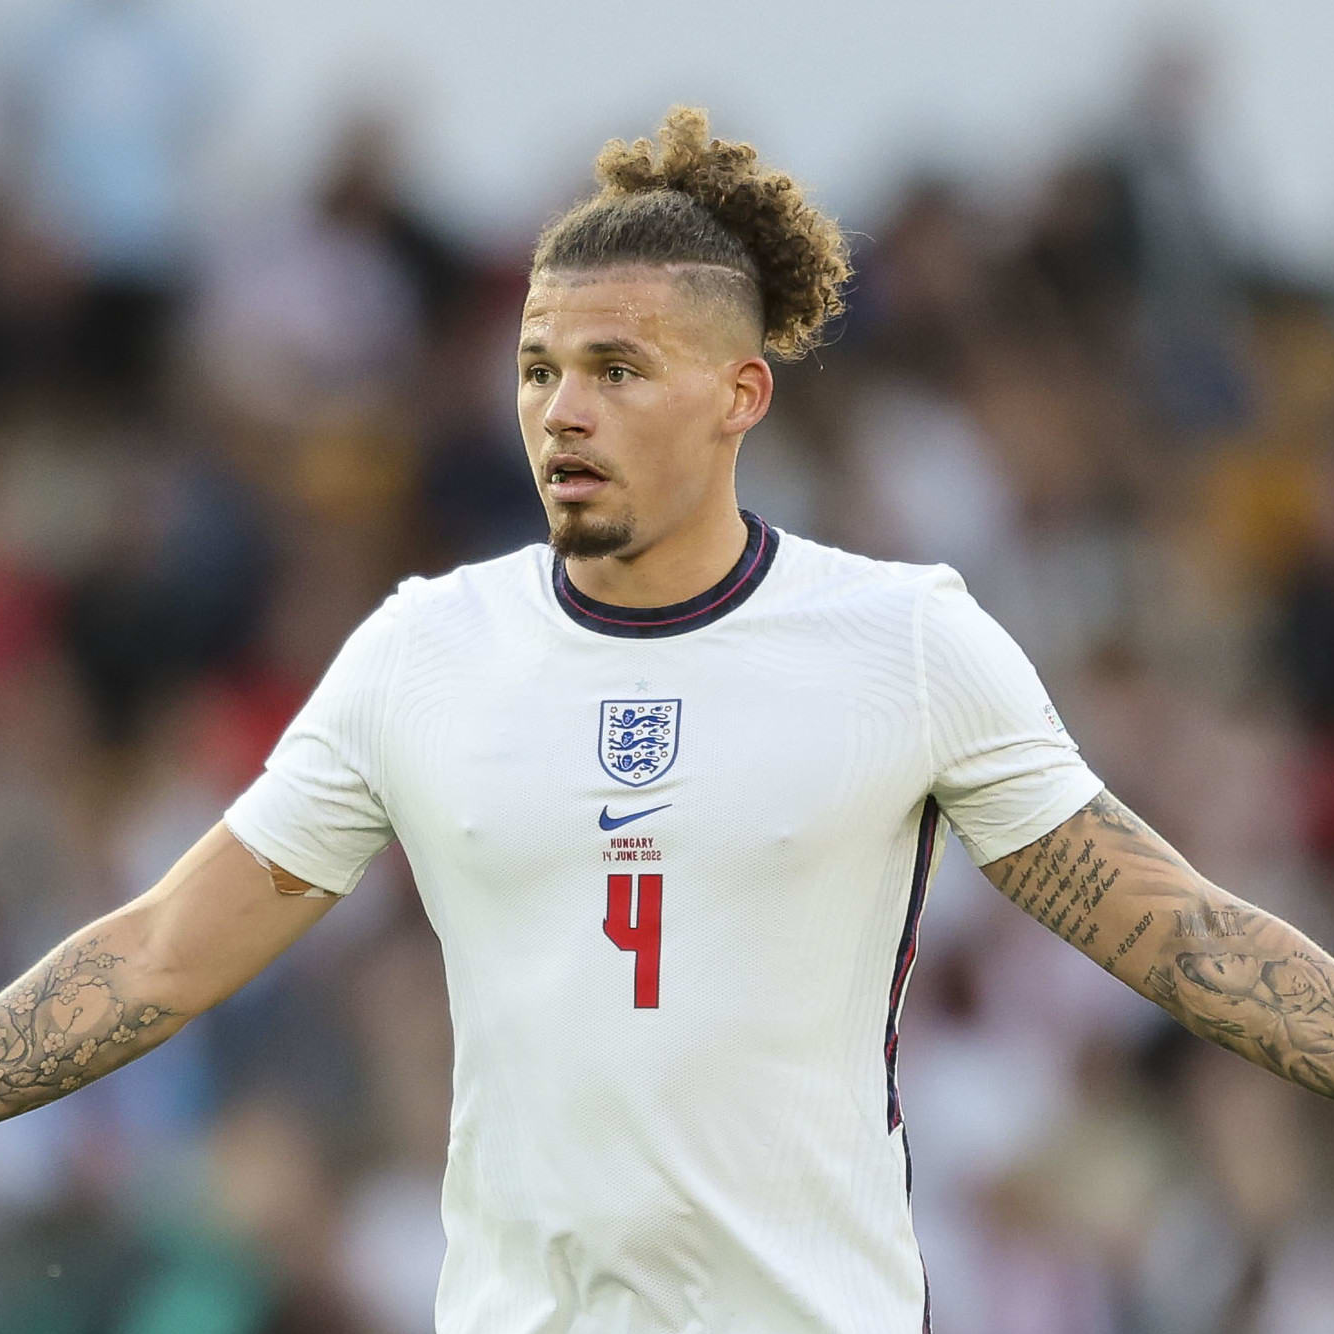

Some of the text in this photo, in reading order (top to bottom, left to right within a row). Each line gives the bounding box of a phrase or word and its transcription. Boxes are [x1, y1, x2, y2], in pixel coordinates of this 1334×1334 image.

[610, 837, 654, 849] HUNGARY
[602, 850, 662, 862] 14 JUNE 2022
[1069, 864, 1077, 876] or
[1077, 838, 1096, 865] night
[602, 873, 663, 1009] 4
